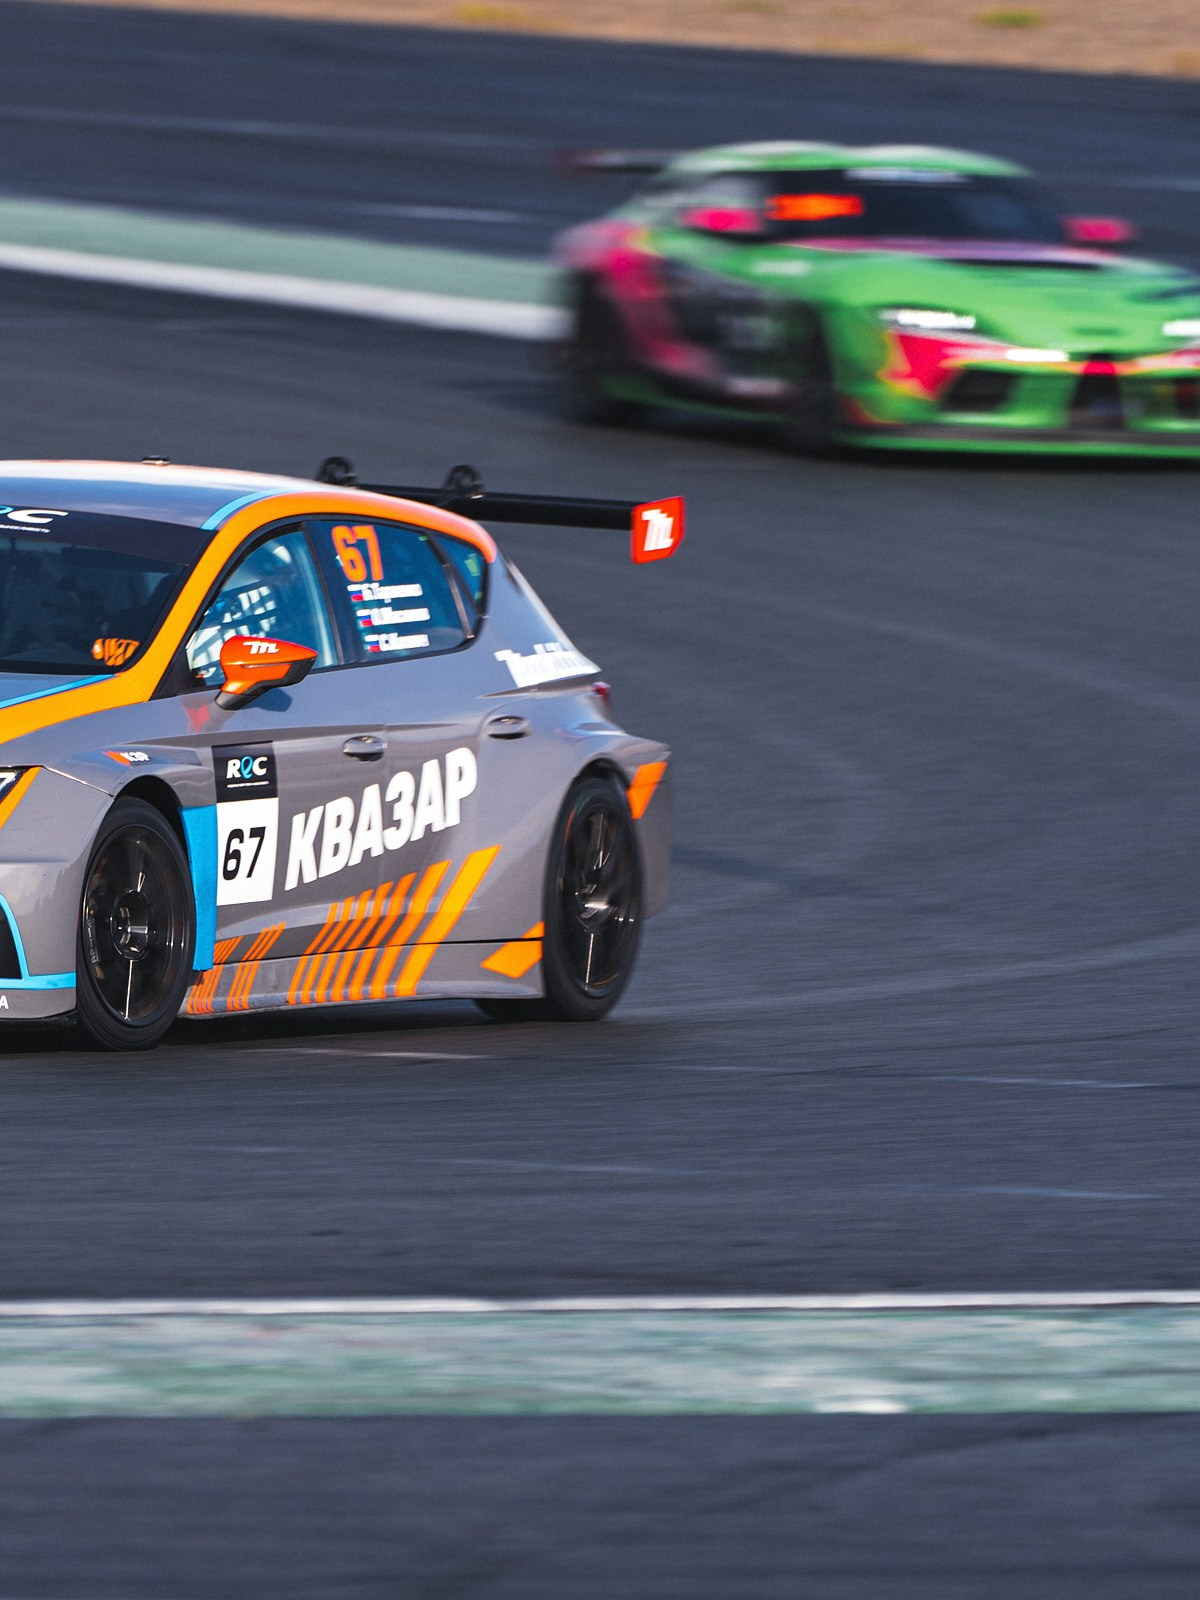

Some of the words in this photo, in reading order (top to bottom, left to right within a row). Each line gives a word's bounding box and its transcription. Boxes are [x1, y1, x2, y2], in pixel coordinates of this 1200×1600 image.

[331, 525, 384, 582] 67
[284, 747, 477, 891] КВАЗАР
[222, 826, 266, 881] 67
